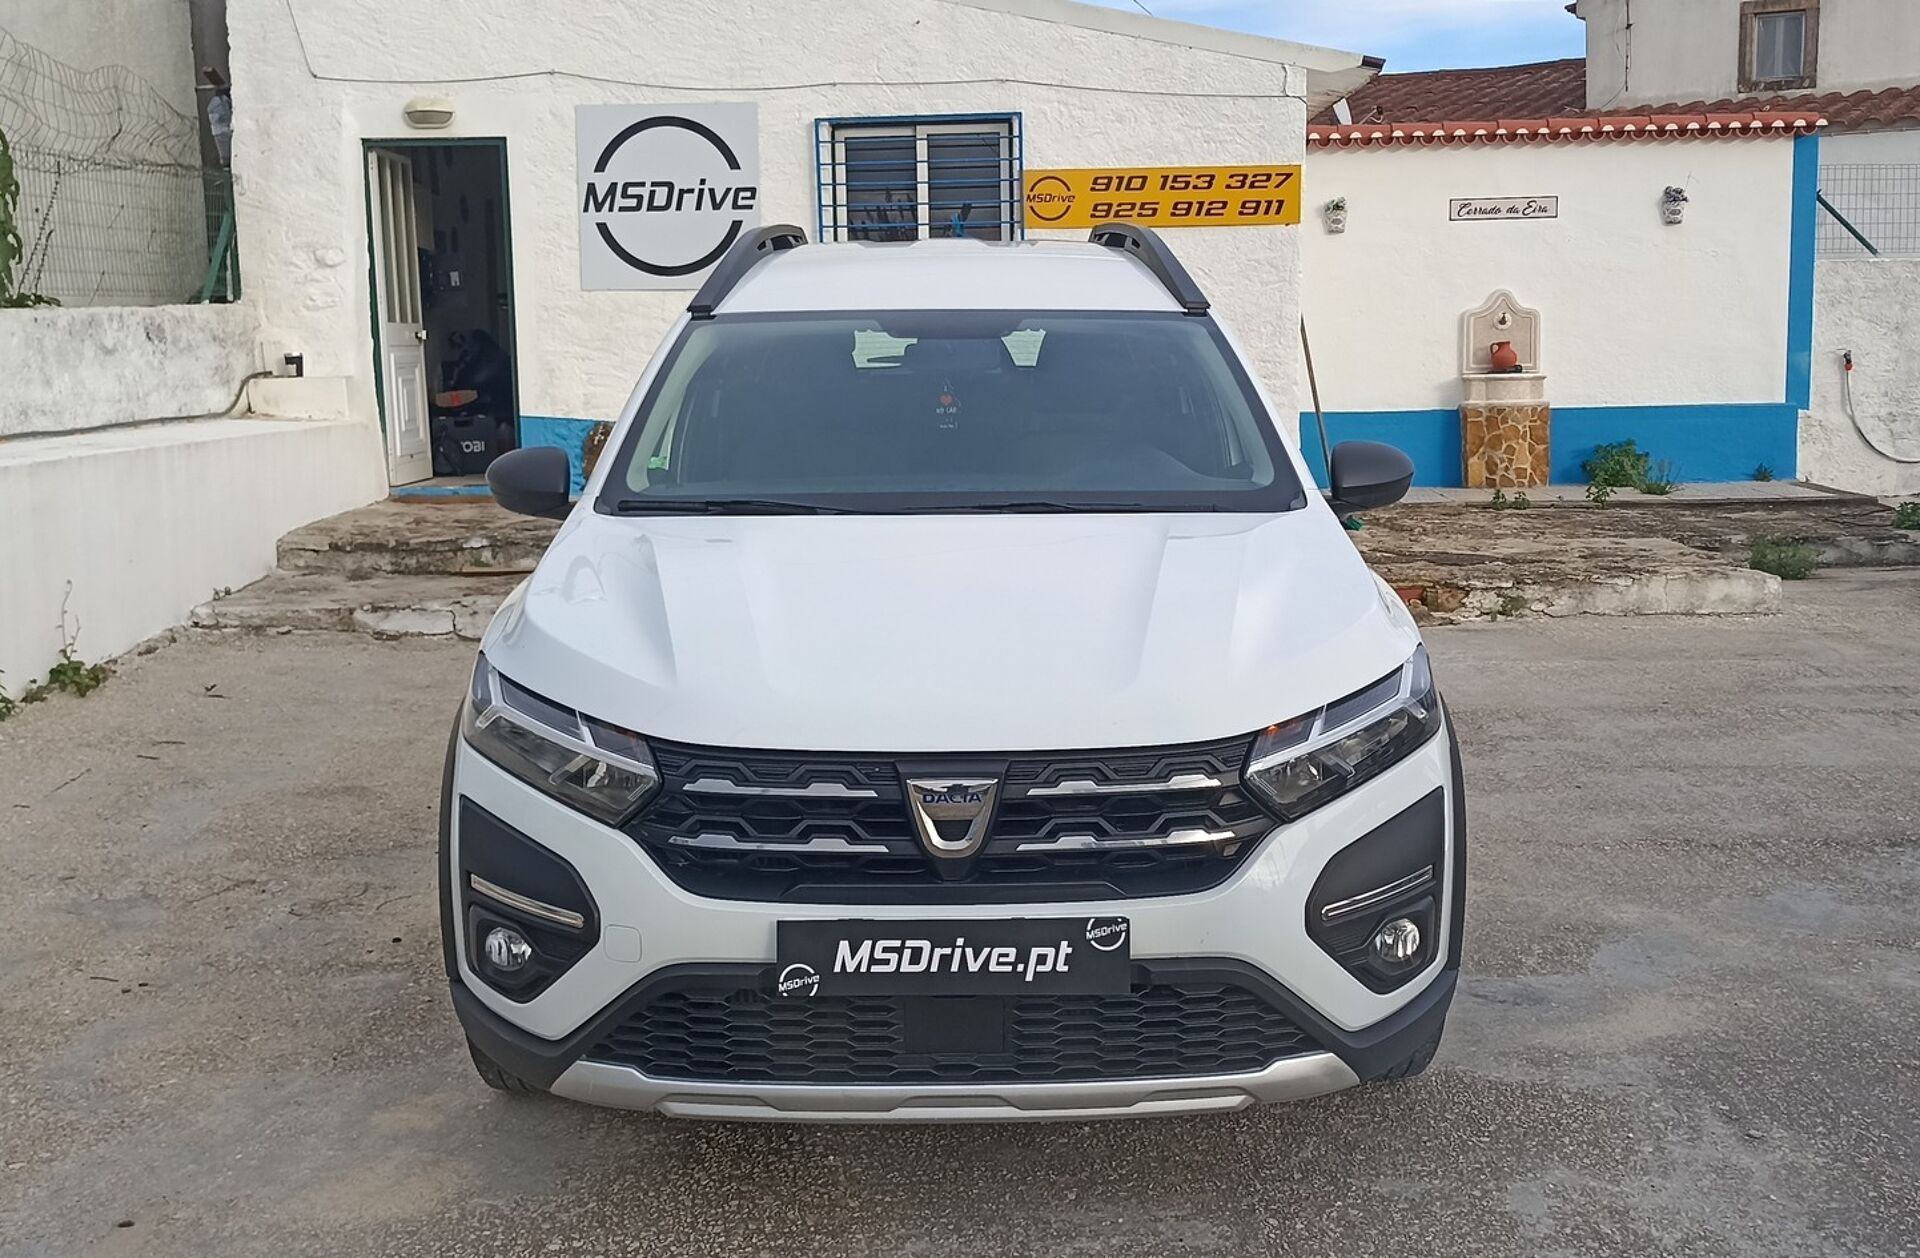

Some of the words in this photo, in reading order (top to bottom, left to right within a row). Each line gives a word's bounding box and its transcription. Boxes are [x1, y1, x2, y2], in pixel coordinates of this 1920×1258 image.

[1090, 175, 1148, 192] 910
[1159, 173, 1216, 191] 153
[1225, 172, 1293, 189] 327
[582, 178, 757, 213] MSDrive
[1026, 193, 1076, 203] MSDrive
[1090, 201, 1160, 219] 925
[1170, 200, 1228, 217] 912
[1238, 199, 1285, 216] 911
[1457, 202, 1501, 217] Cerrado
[1506, 205, 1520, 215] da
[1521, 200, 1548, 216] Eira
[460, 441, 486, 453] OBI
[922, 793, 982, 803] DACIA
[1085, 923, 1127, 940] MSDrive
[833, 937, 1073, 982] MSDrive.pt
[778, 975, 820, 992] MSDrive
